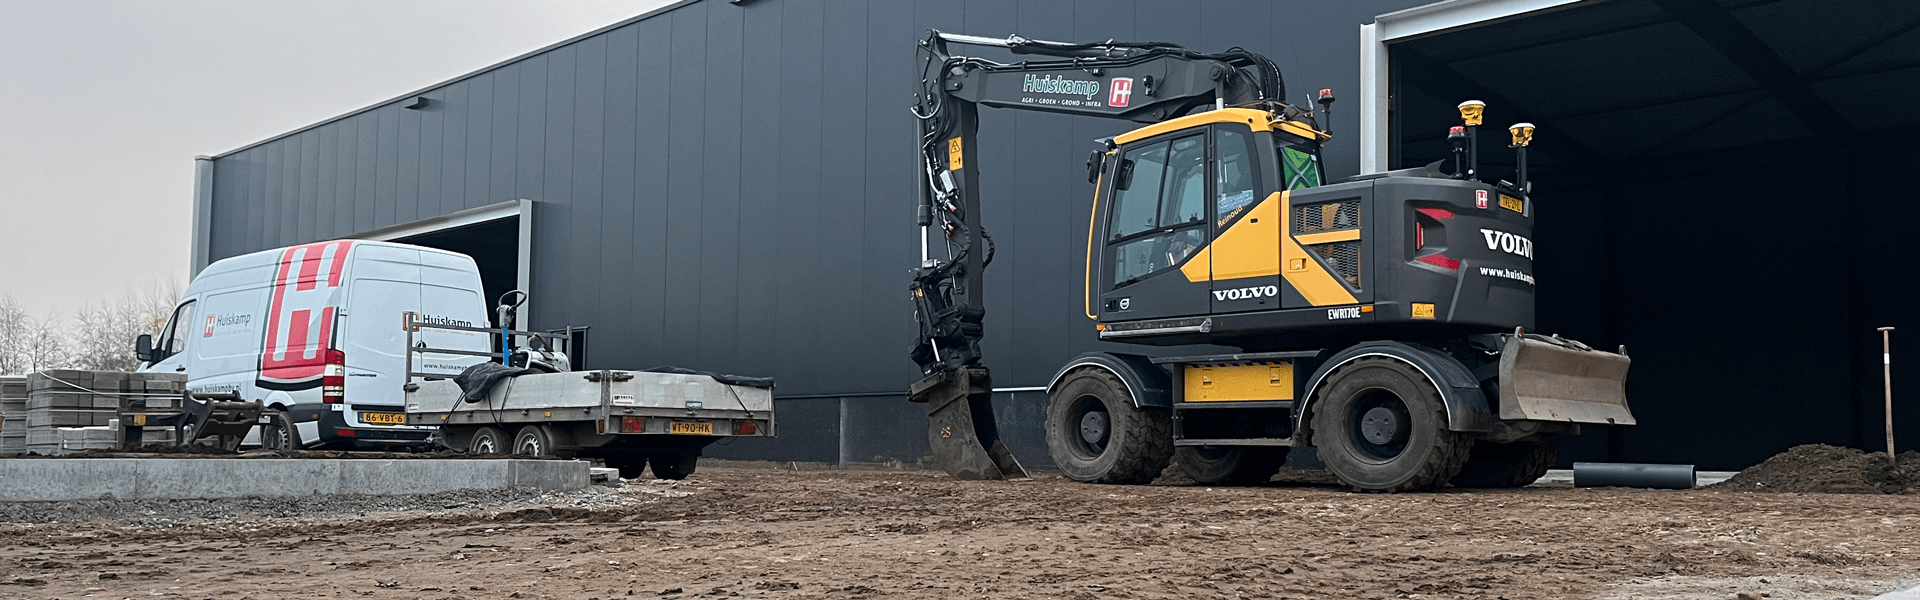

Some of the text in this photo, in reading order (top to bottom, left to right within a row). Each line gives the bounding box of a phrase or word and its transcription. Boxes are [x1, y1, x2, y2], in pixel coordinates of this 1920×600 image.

[1023, 73, 1099, 100] Huiskamp
[1217, 204, 1243, 228] Reinoud
[1479, 266, 1535, 286] www.huiskamp
[1212, 285, 1278, 301] VOLVO
[216, 313, 251, 327] Huiskamp
[422, 313, 472, 328] Huiskamp
[1327, 307, 1361, 320] EWR170E
[365, 413, 403, 423] 86-VBT-6
[672, 423, 710, 433] WT-90-HK
